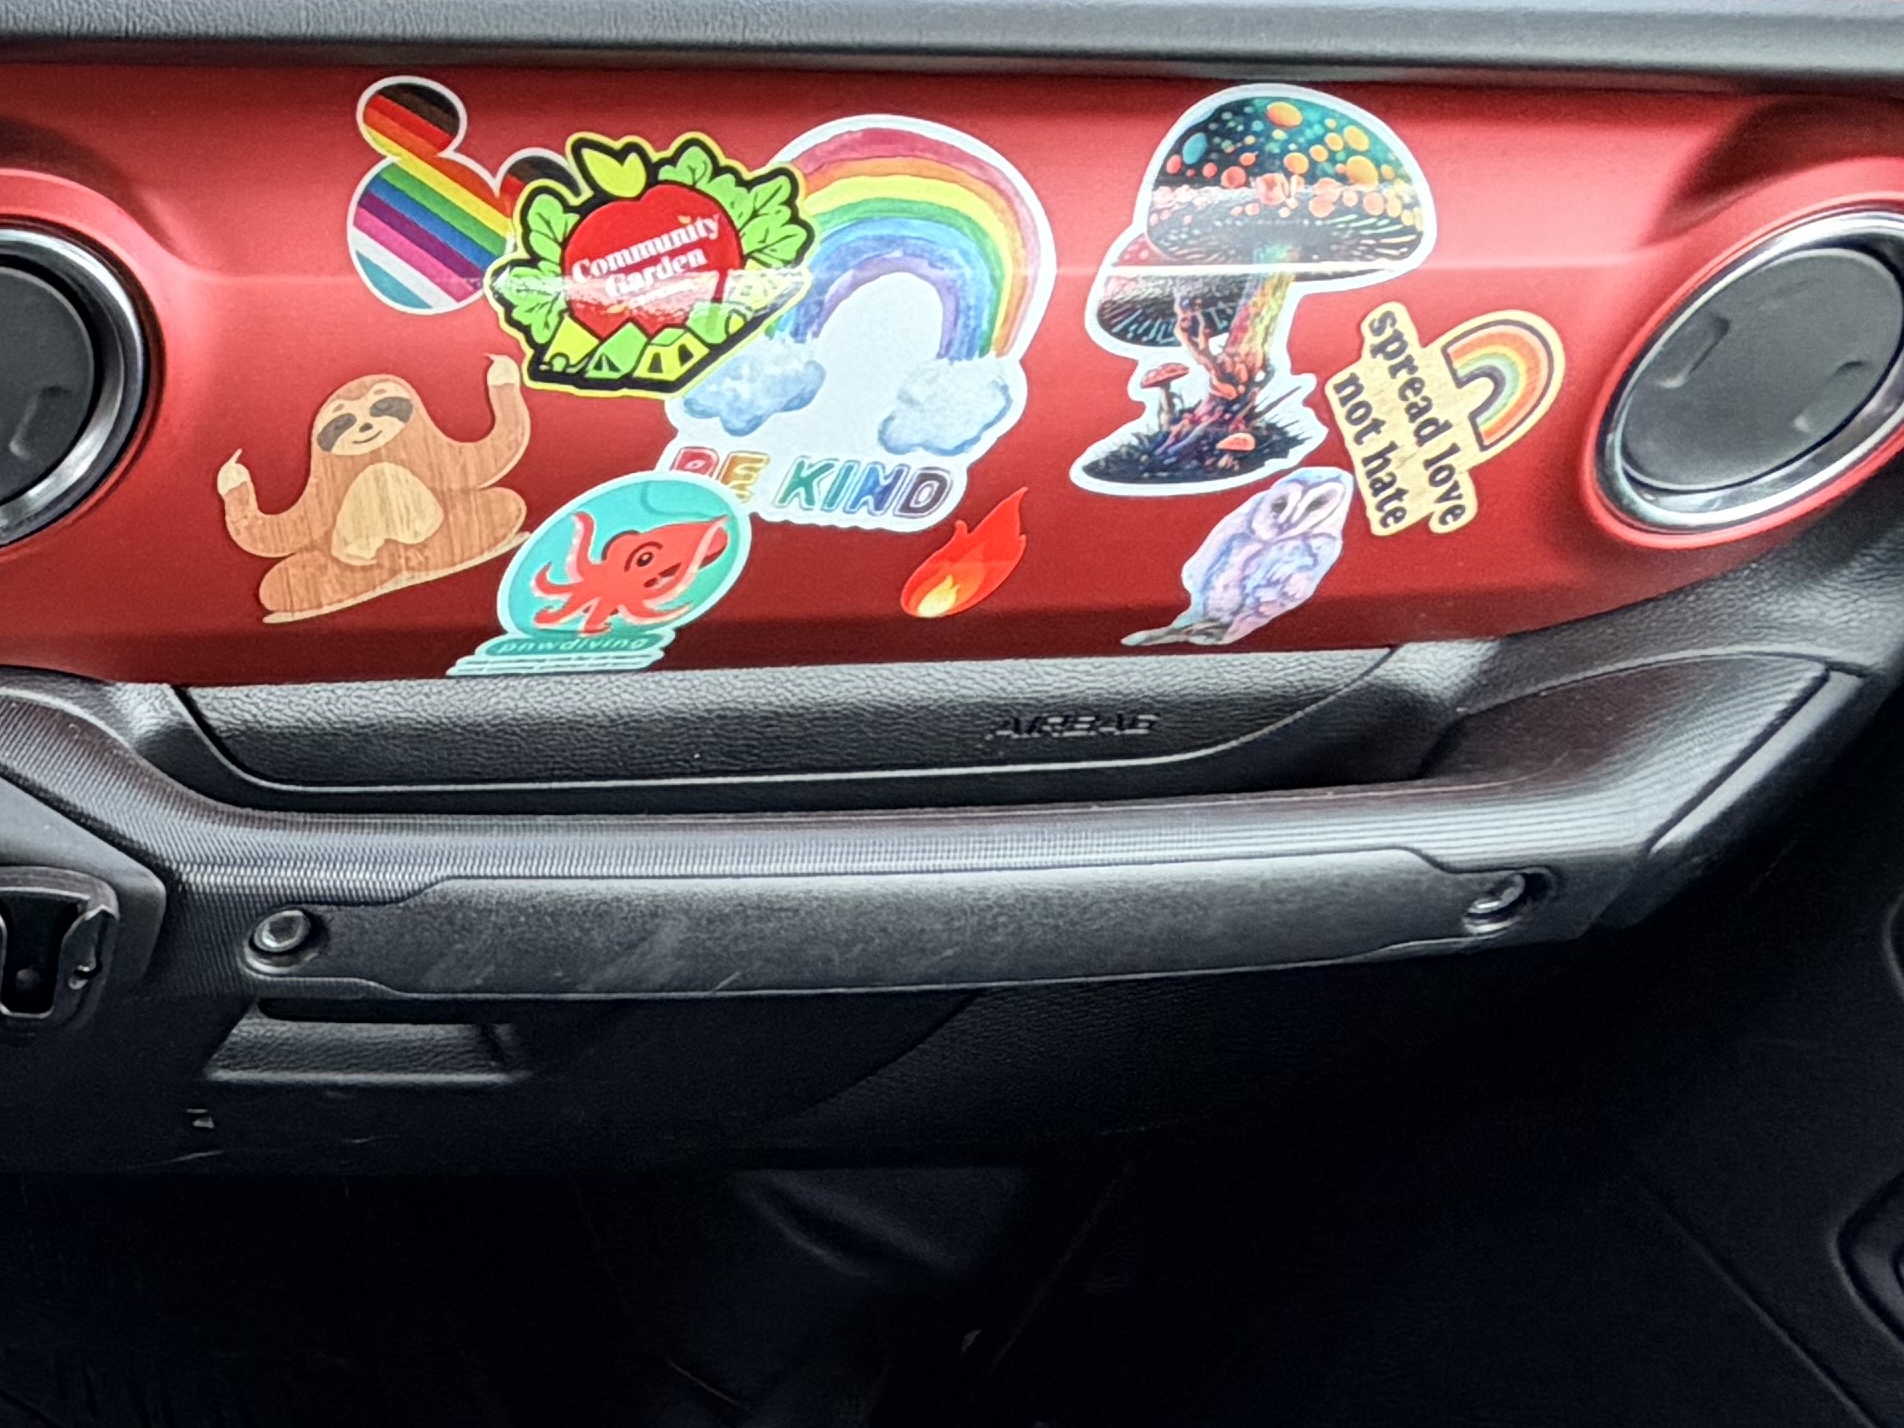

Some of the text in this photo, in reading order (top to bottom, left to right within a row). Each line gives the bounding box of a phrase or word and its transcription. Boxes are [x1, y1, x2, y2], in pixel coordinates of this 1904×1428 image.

[571, 212, 721, 283] Community
[605, 248, 708, 298] Garden
[1332, 371, 1409, 529] not hate
[1369, 310, 1467, 526] spread love
[771, 454, 954, 520] KIND
[496, 635, 653, 655] pnwdiving
[992, 711, 1159, 738] AIRBAG
